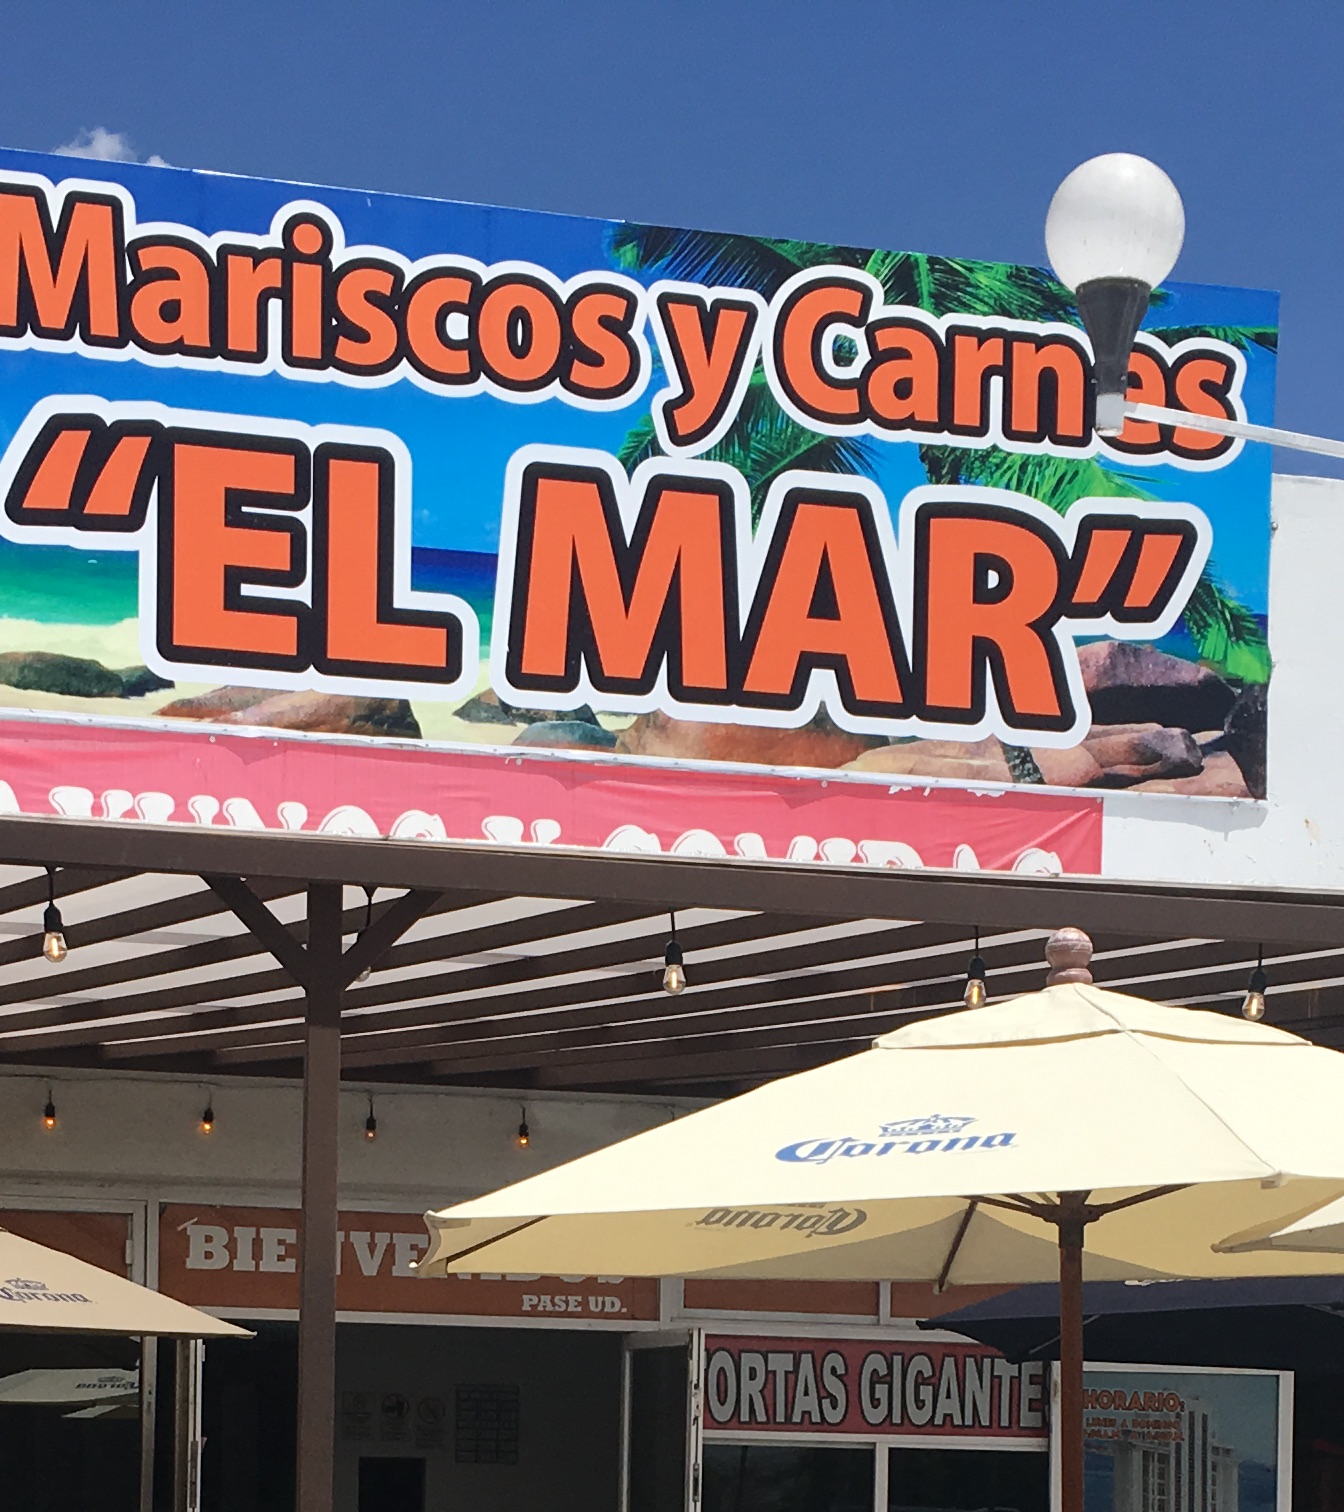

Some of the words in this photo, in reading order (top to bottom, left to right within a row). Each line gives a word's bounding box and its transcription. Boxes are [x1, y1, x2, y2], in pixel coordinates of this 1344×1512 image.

[658, 290, 759, 448] y
[771, 278, 1238, 461] Carnes
[774, 1132, 1019, 1165] Corona
[521, 1294, 583, 1312] PASE
[588, 1295, 628, 1313] UD.
[704, 1350, 848, 1424] ORTAS
[860, 1352, 1050, 1429] GIGANTE
